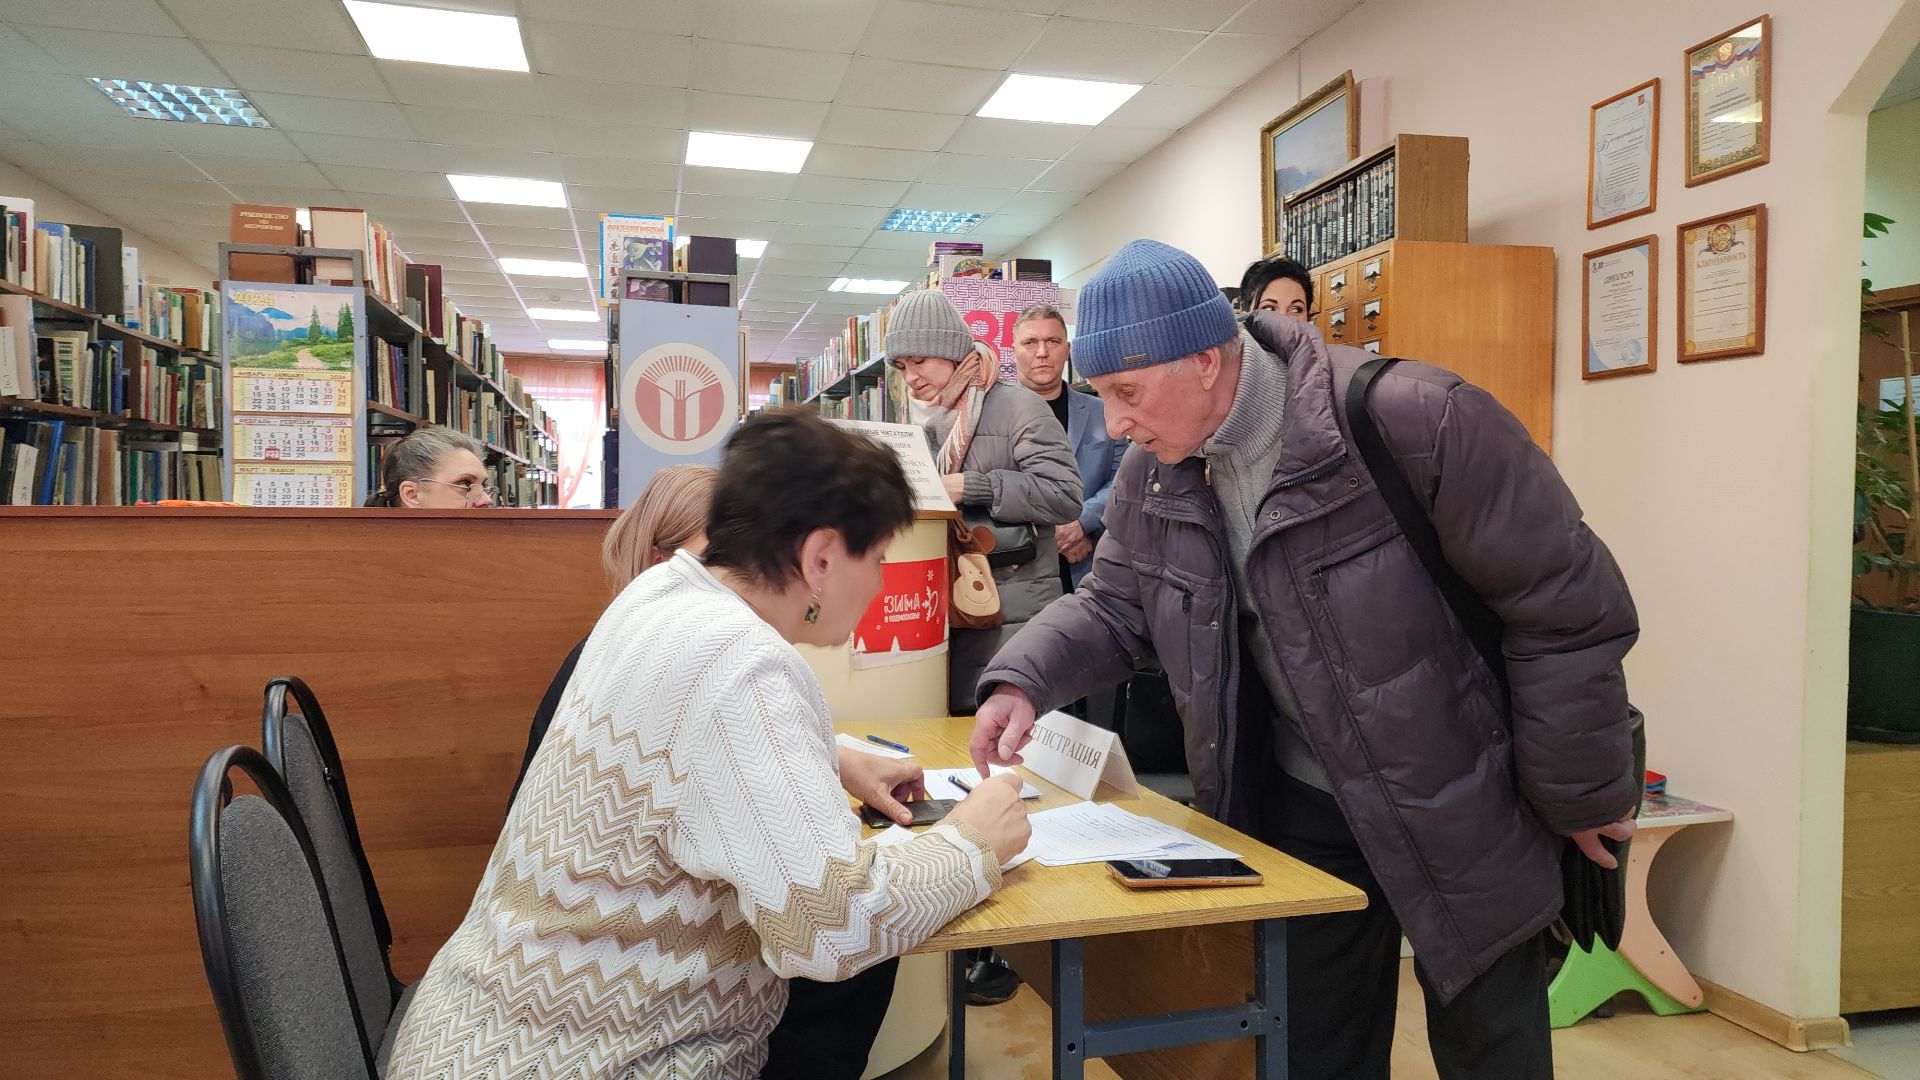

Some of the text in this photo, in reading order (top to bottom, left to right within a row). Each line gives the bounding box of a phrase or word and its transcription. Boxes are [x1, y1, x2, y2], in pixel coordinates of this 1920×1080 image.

[233, 292, 275, 306] 2024
[884, 593, 920, 614] ЗИМА
[1031, 724, 1102, 769] ЕГИСТРАЦИЯ
